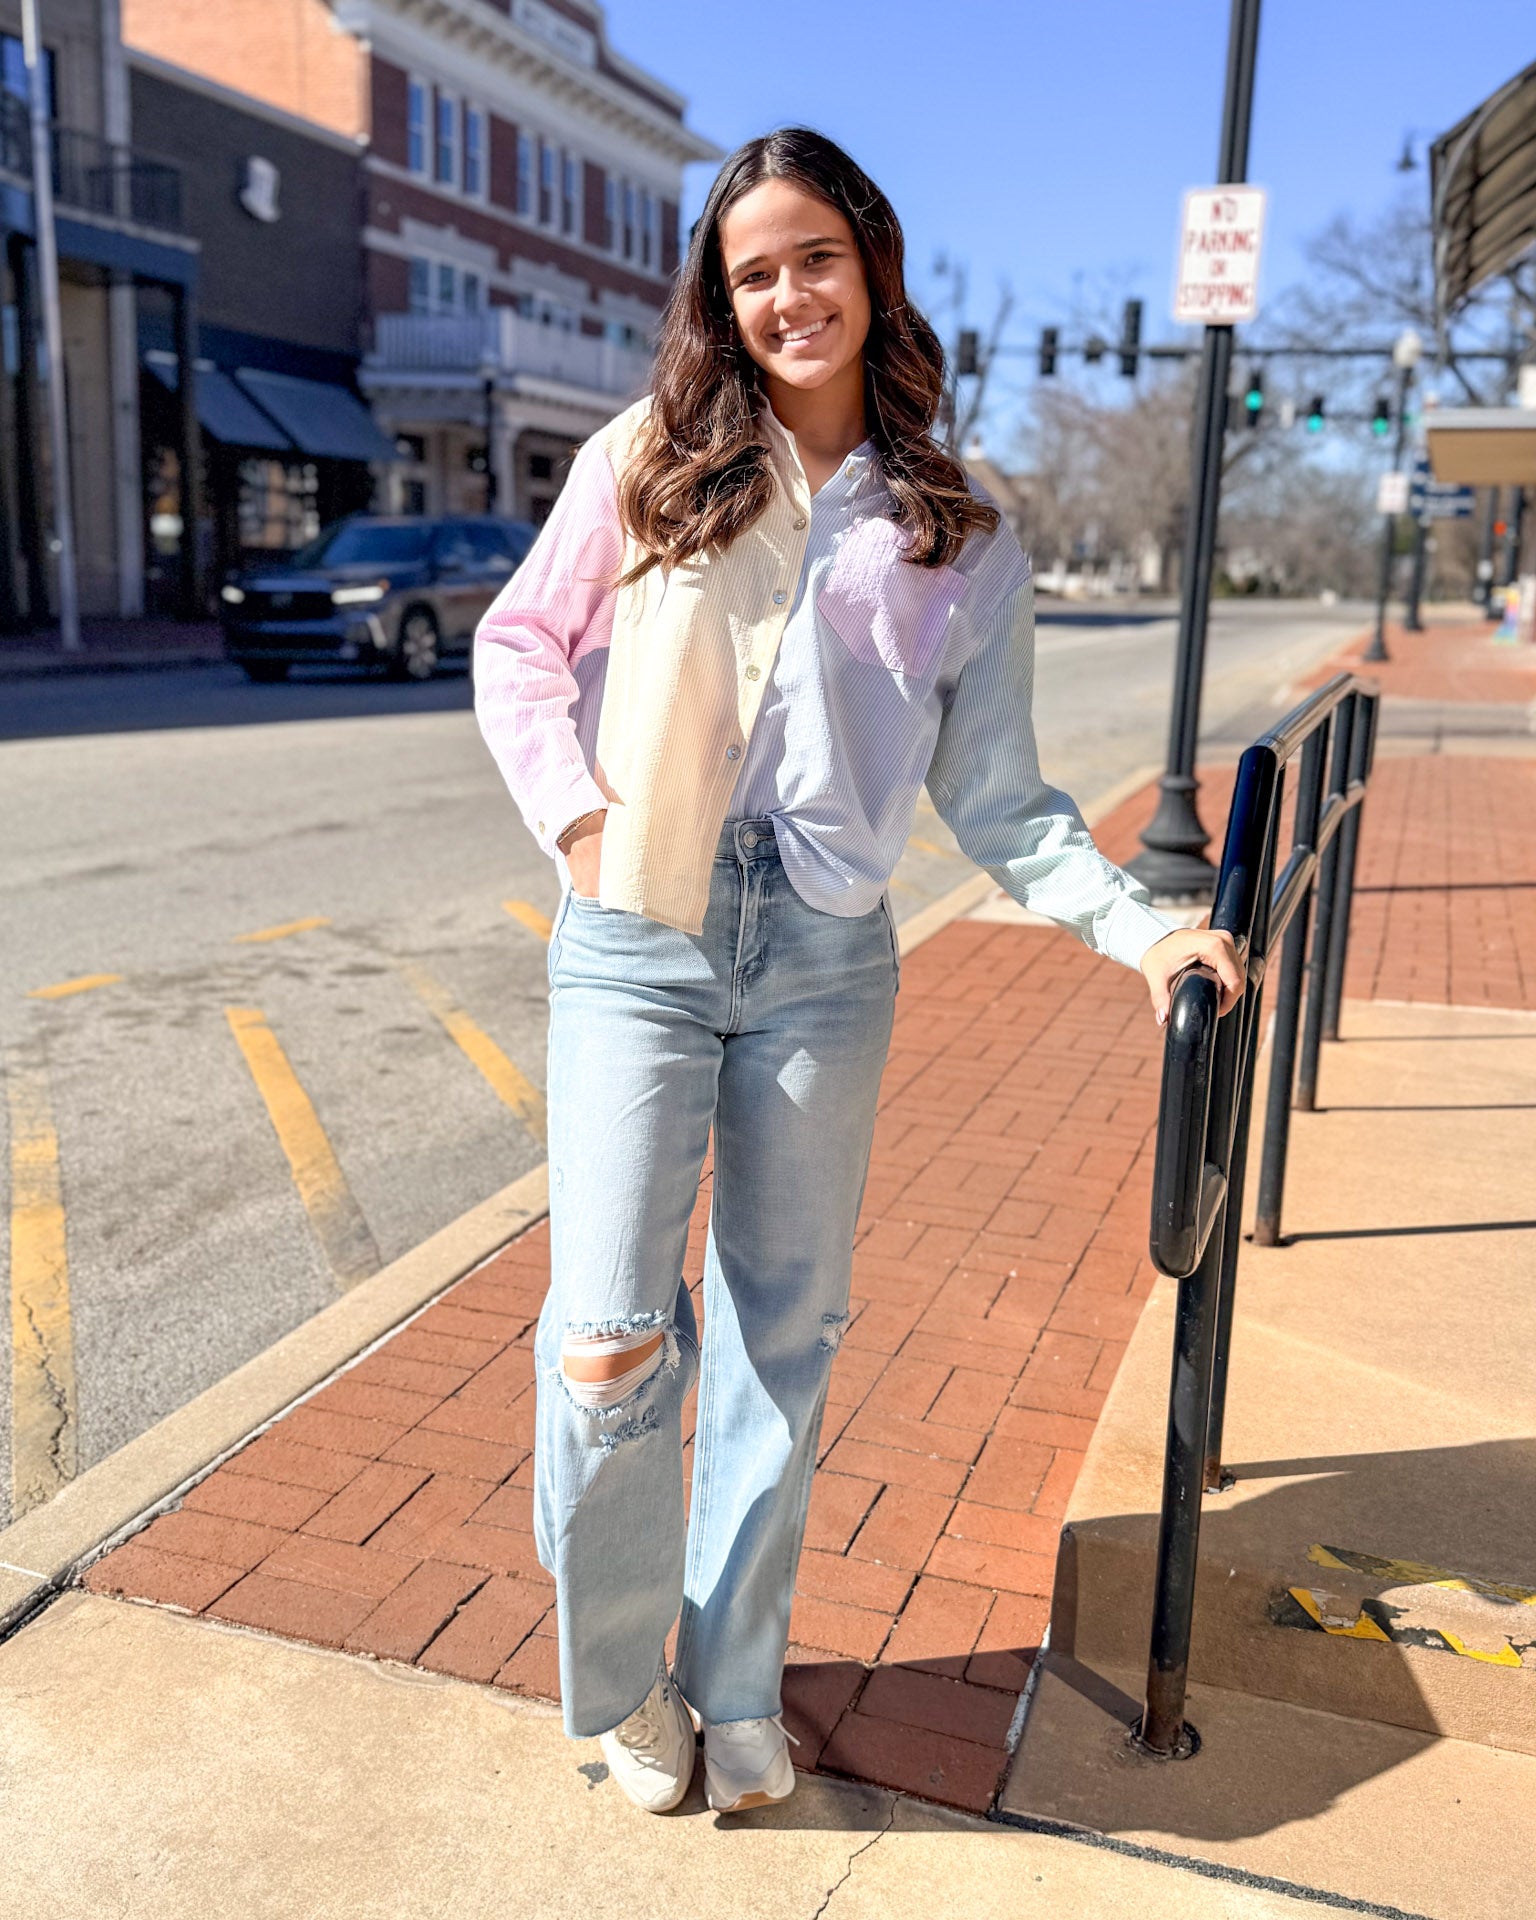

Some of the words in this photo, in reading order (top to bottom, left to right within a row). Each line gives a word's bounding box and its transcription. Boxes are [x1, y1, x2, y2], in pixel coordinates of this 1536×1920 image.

[1212, 199, 1238, 222] NO
[1185, 230, 1257, 253] PARKING
[1179, 284, 1255, 307] STOPPING
